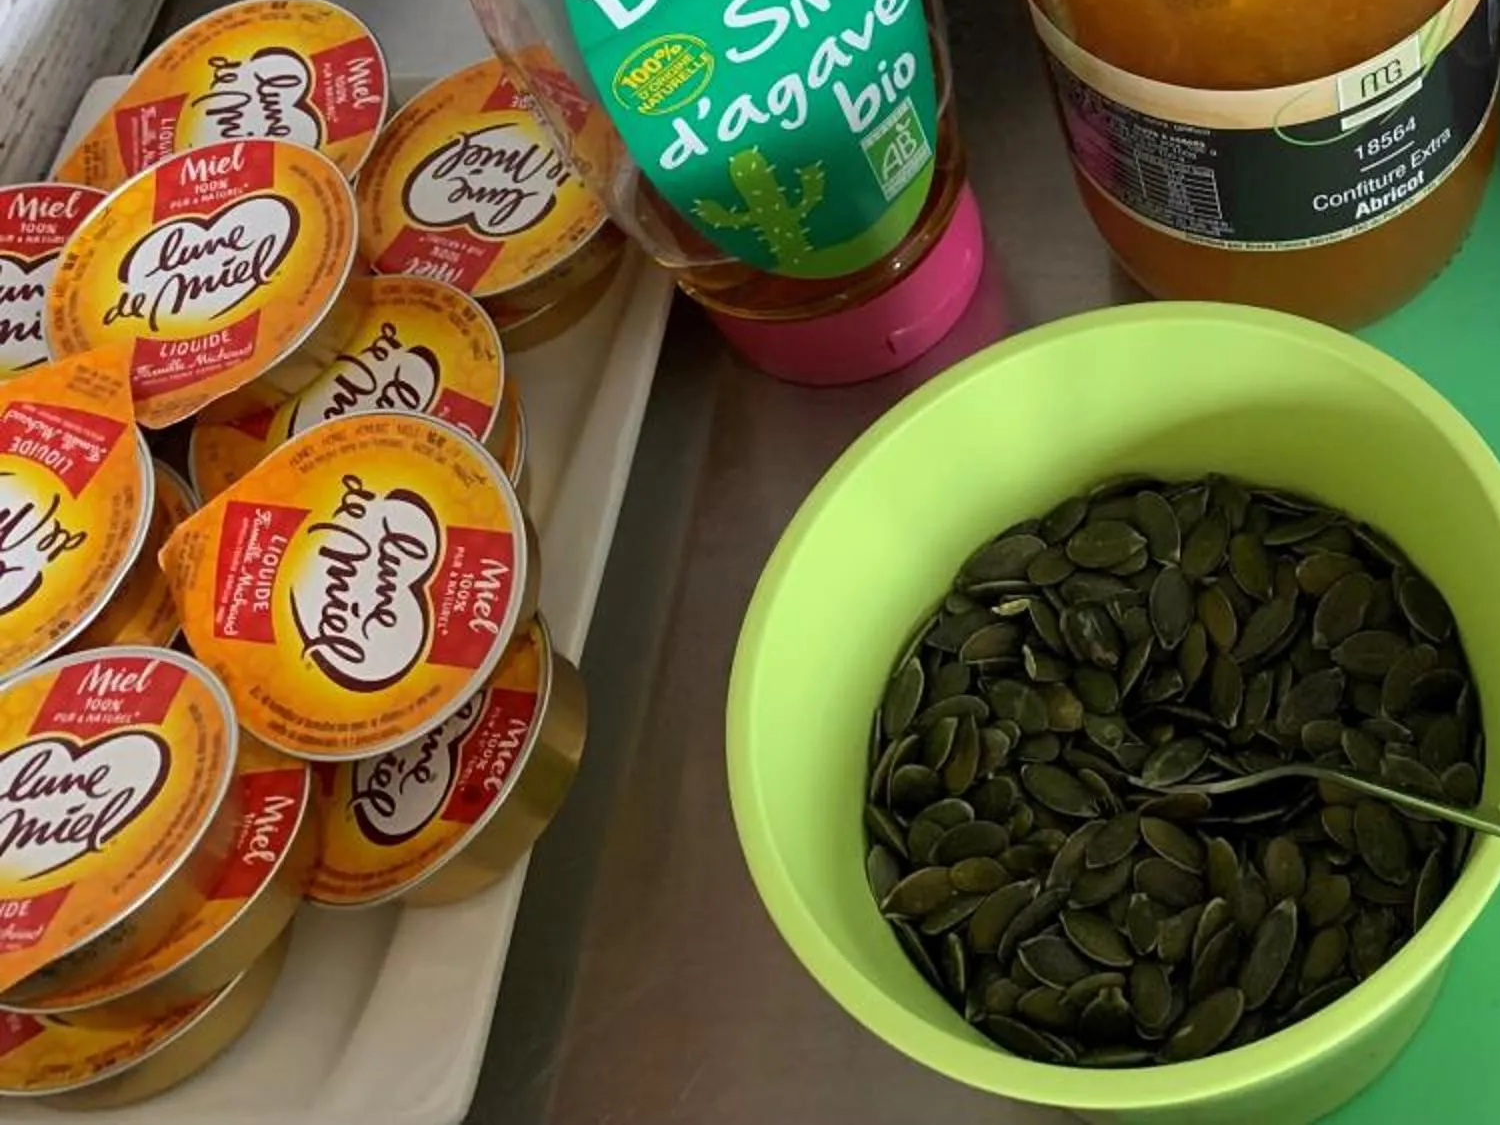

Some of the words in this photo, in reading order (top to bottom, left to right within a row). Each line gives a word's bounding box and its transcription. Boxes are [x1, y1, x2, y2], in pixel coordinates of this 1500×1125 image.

[207, 56, 243, 88] de
[346, 56, 382, 110] Miel
[620, 43, 683, 90] 100%
[254, 71, 301, 137] lune
[832, 51, 917, 134] bio
[1353, 116, 1418, 161] 18564
[180, 143, 246, 185] Miel
[1312, 161, 1408, 214] Confiture
[1410, 128, 1453, 169] Extra
[7, 190, 81, 222] Miel
[194, 180, 229, 195] 100%
[447, 176, 539, 228] lune
[1355, 171, 1426, 220] Abricot
[144, 225, 255, 278] lune
[102, 292, 147, 326] de
[159, 331, 233, 358] LIQUIDE
[360, 322, 404, 362] de
[10, 435, 75, 475] LIQUIDE
[331, 474, 376, 520] de
[36, 518, 88, 563] de
[252, 533, 289, 613] LIQUIDE
[362, 515, 430, 640] lune
[453, 570, 476, 614] 100%
[468, 557, 510, 635] Miel
[76, 659, 161, 696] Miel
[85, 696, 125, 712] 100%
[0, 748, 113, 803] lune
[482, 717, 529, 792] Miel
[241, 795, 297, 866] Miel
